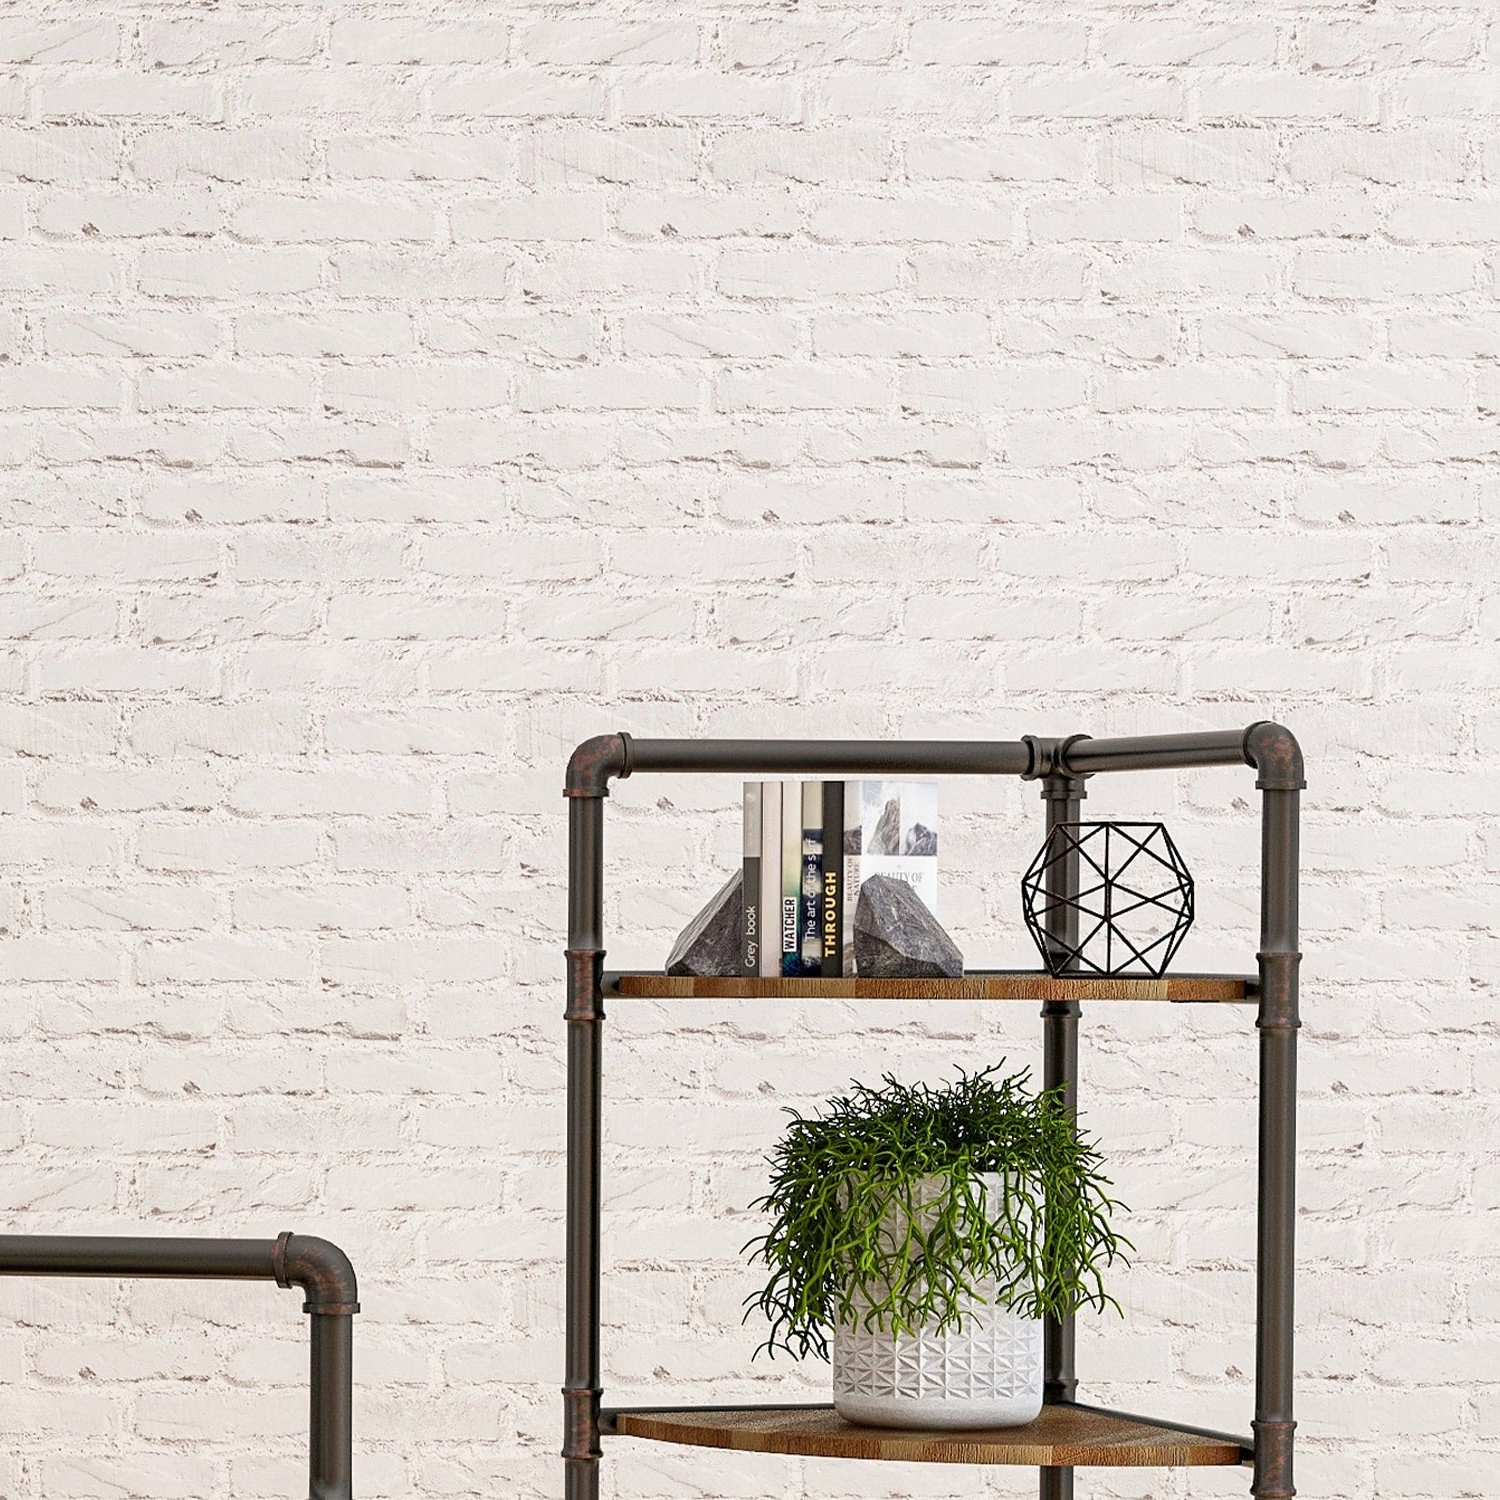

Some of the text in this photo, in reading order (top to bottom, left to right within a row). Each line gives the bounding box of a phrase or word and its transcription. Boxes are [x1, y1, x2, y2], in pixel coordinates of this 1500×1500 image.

[805, 863, 816, 883] the
[911, 871, 924, 883] OF
[806, 900, 816, 918] art
[824, 871, 837, 958] THROUGH
[784, 898, 795, 950] WATCHER
[804, 924, 816, 942] The
[744, 905, 759, 968] Grey book
